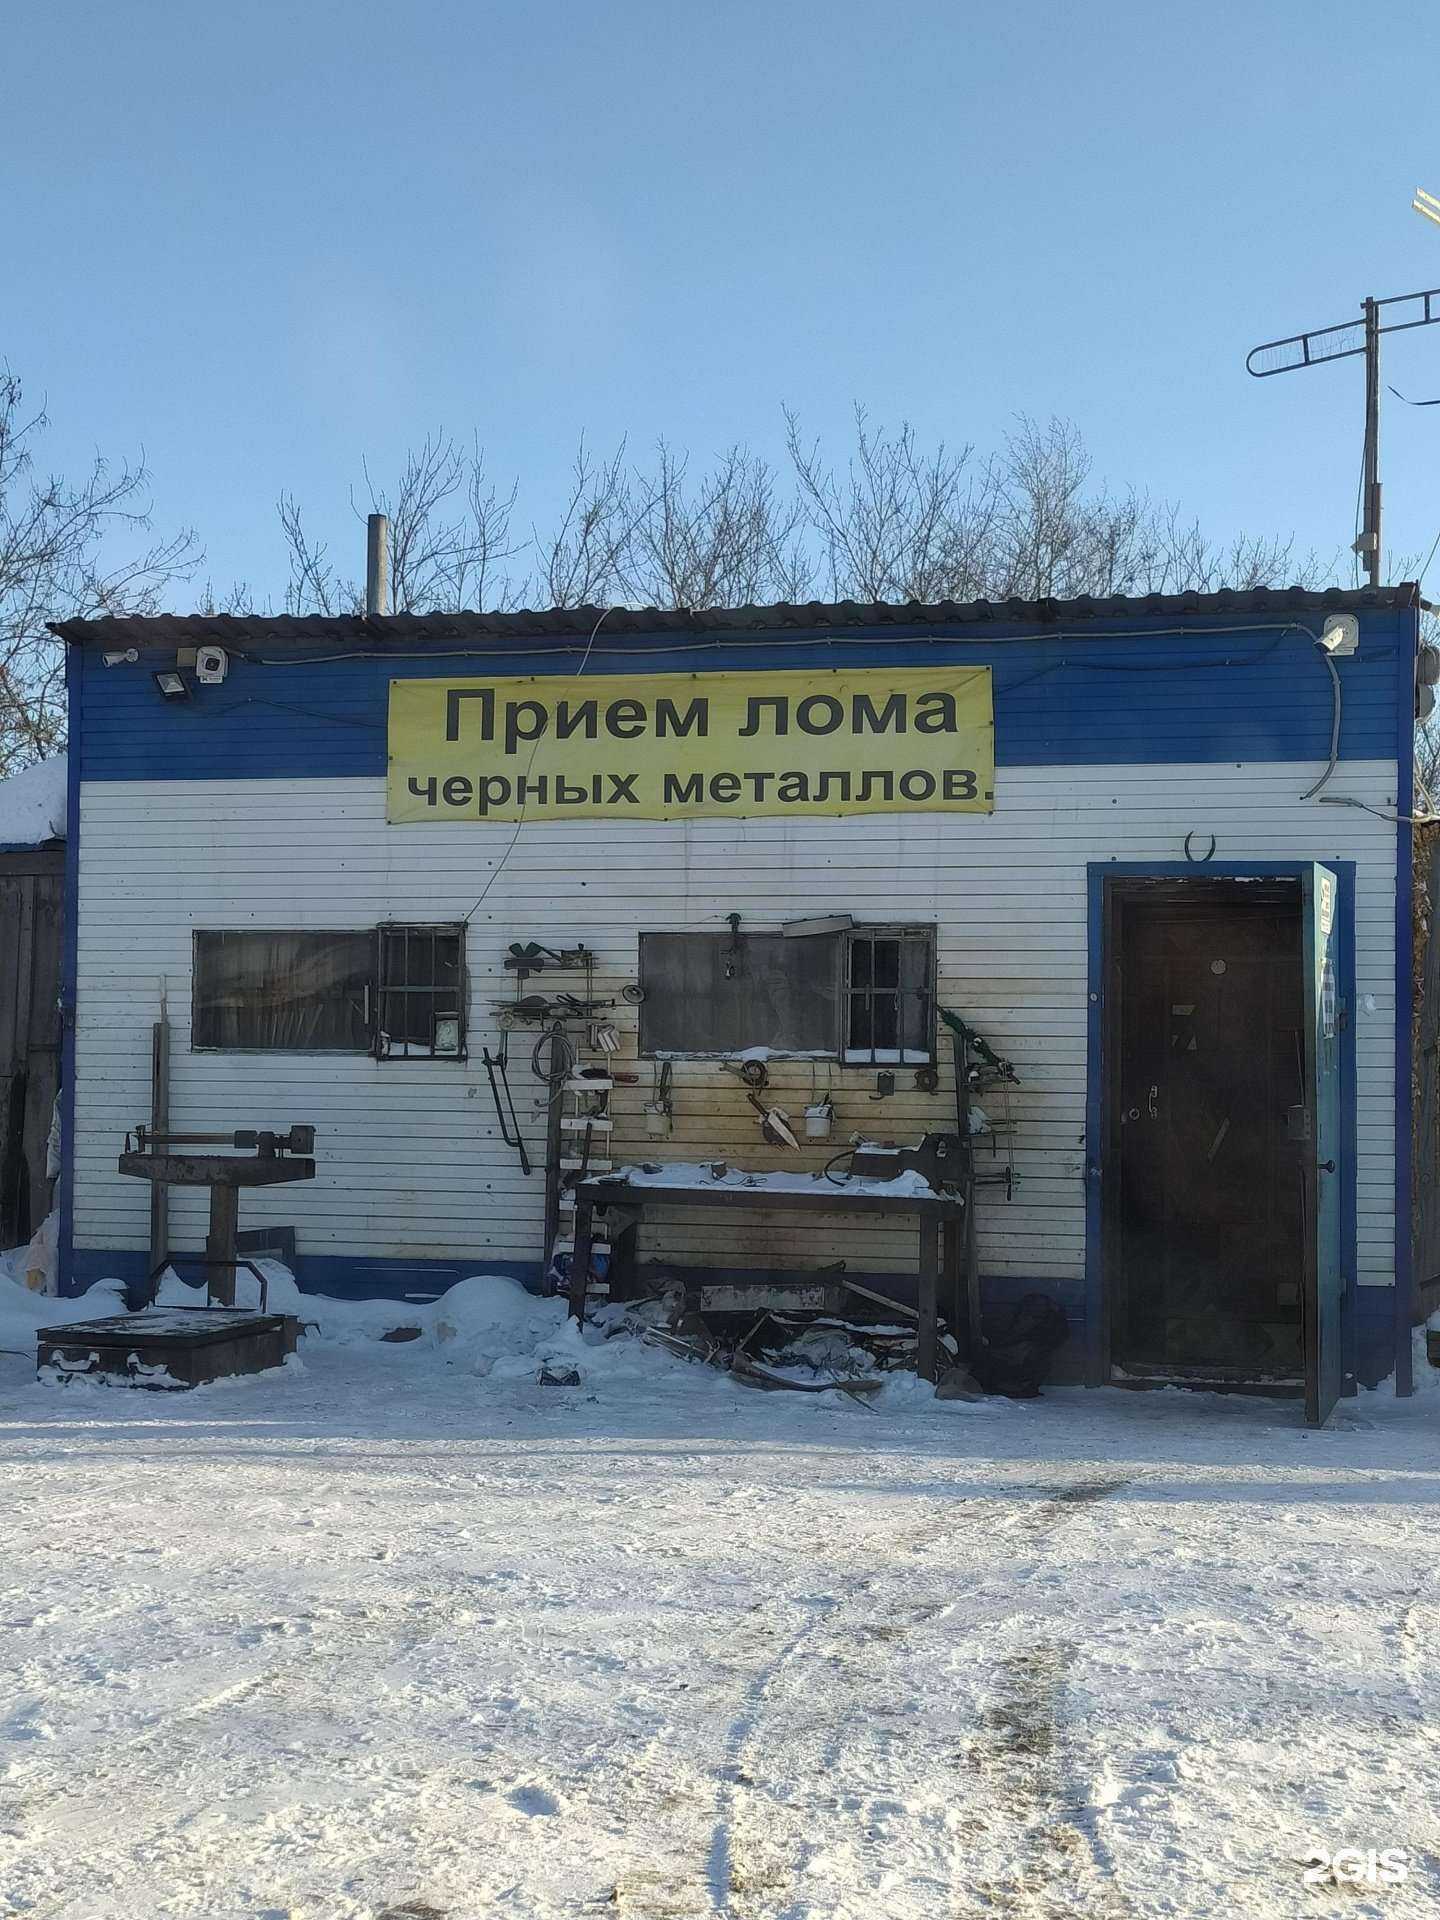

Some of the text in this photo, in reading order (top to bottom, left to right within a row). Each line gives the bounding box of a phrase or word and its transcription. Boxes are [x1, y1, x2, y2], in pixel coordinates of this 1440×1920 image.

[445, 688, 959, 754] Прием лома
[407, 768, 993, 815] черных металлов.
